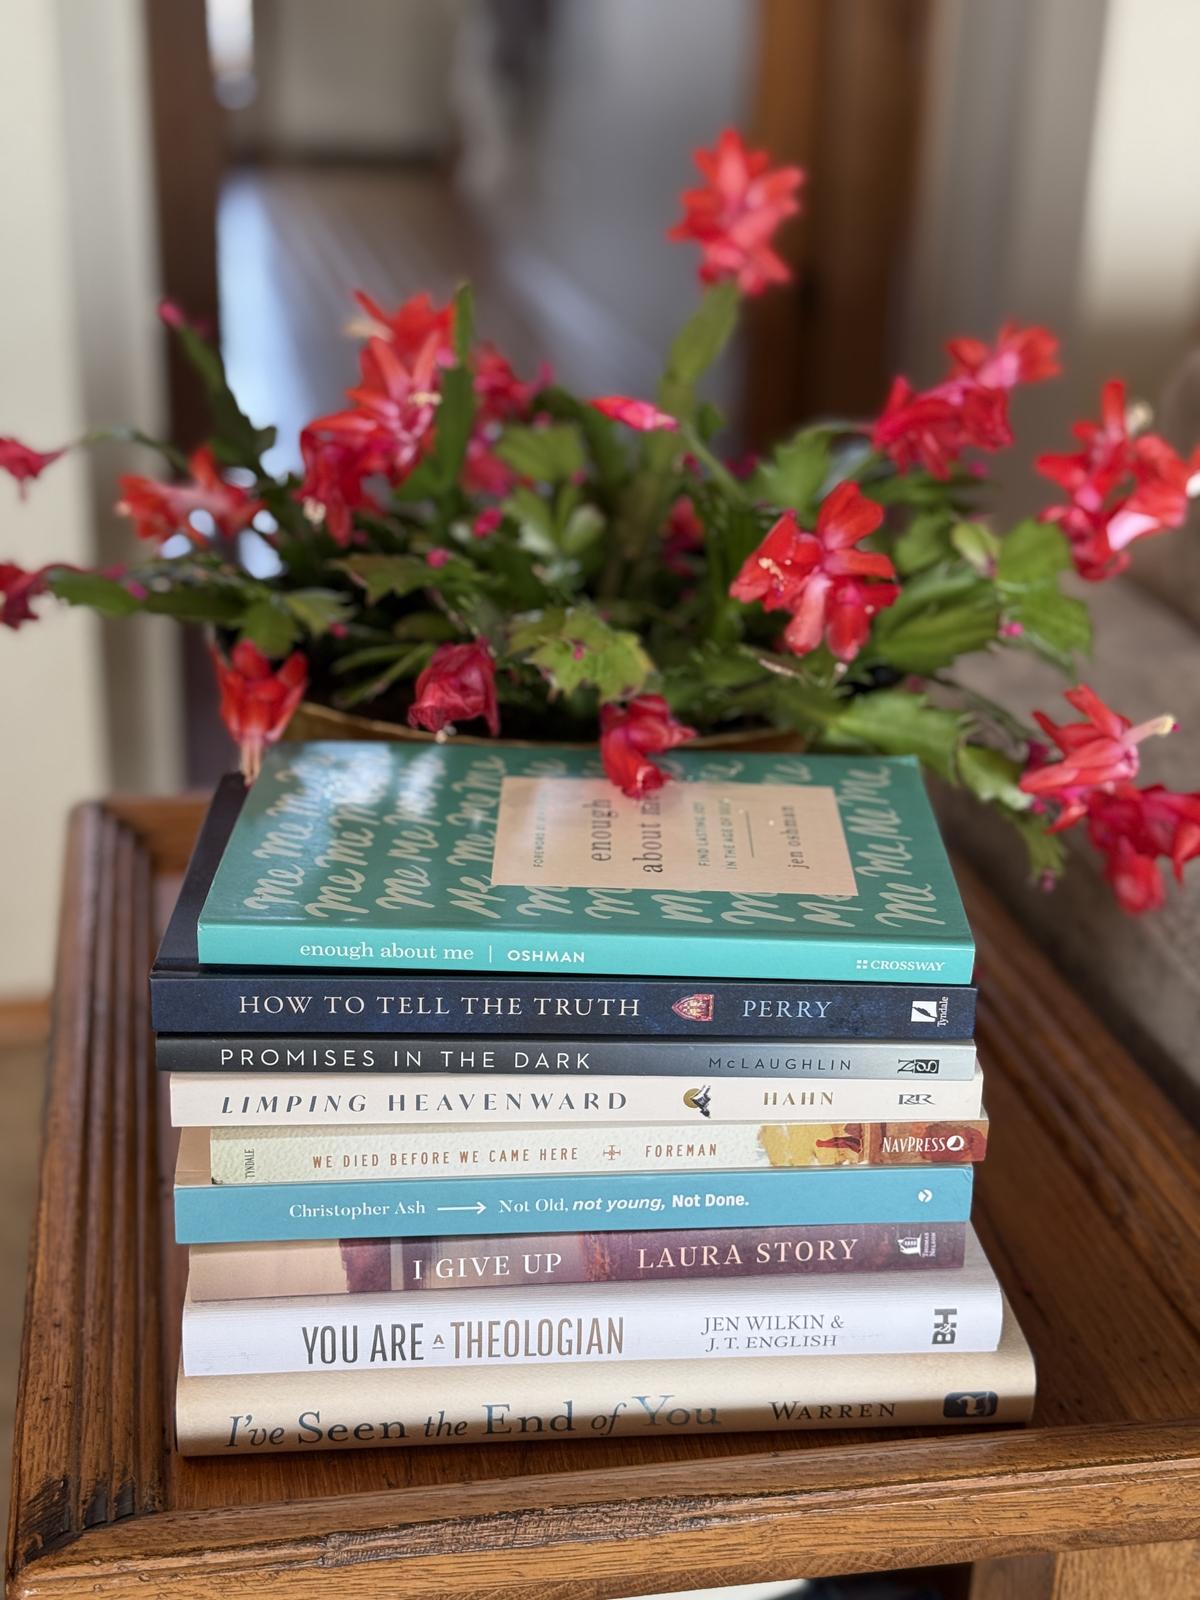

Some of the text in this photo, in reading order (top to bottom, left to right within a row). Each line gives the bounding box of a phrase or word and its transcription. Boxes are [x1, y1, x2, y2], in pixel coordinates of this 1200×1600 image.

[632, 822, 664, 873] about
[787, 851, 810, 870] jen
[299, 941, 474, 961] enough about me
[507, 949, 585, 963] OSHMAN
[870, 960, 945, 972] CROSSWAY
[239, 996, 641, 1018] HOW TO TELL THE TRUTH
[742, 1000, 833, 1019] PERRY
[936, 996, 949, 1028] Tyndale
[220, 1048, 591, 1070] PROMISES IN THE DARK
[708, 1057, 852, 1071] McLAUGHLIN
[221, 1092, 628, 1114] LIMPING HEAVENWARD
[762, 1091, 834, 1106] HAHN
[313, 1147, 579, 1169] WE DIED BEFORE WE CAME HERE
[645, 1143, 718, 1159] FOREMAN
[244, 1148, 256, 1179] TYNDALE
[288, 1201, 426, 1219] Christopher Ash
[499, 1193, 750, 1214] Not Old, not young, Not Done.
[637, 1238, 860, 1270] LAURA STORY
[412, 1253, 563, 1281] I GIVE UP
[701, 1314, 844, 1335] JEN WILKIN &
[302, 1317, 624, 1365] YOU ARE A THEOLOGIAN
[706, 1335, 838, 1353] J. T. ENGLISH
[226, 1394, 722, 1448] I've Seen the End of You
[769, 1400, 896, 1421] WARREN
